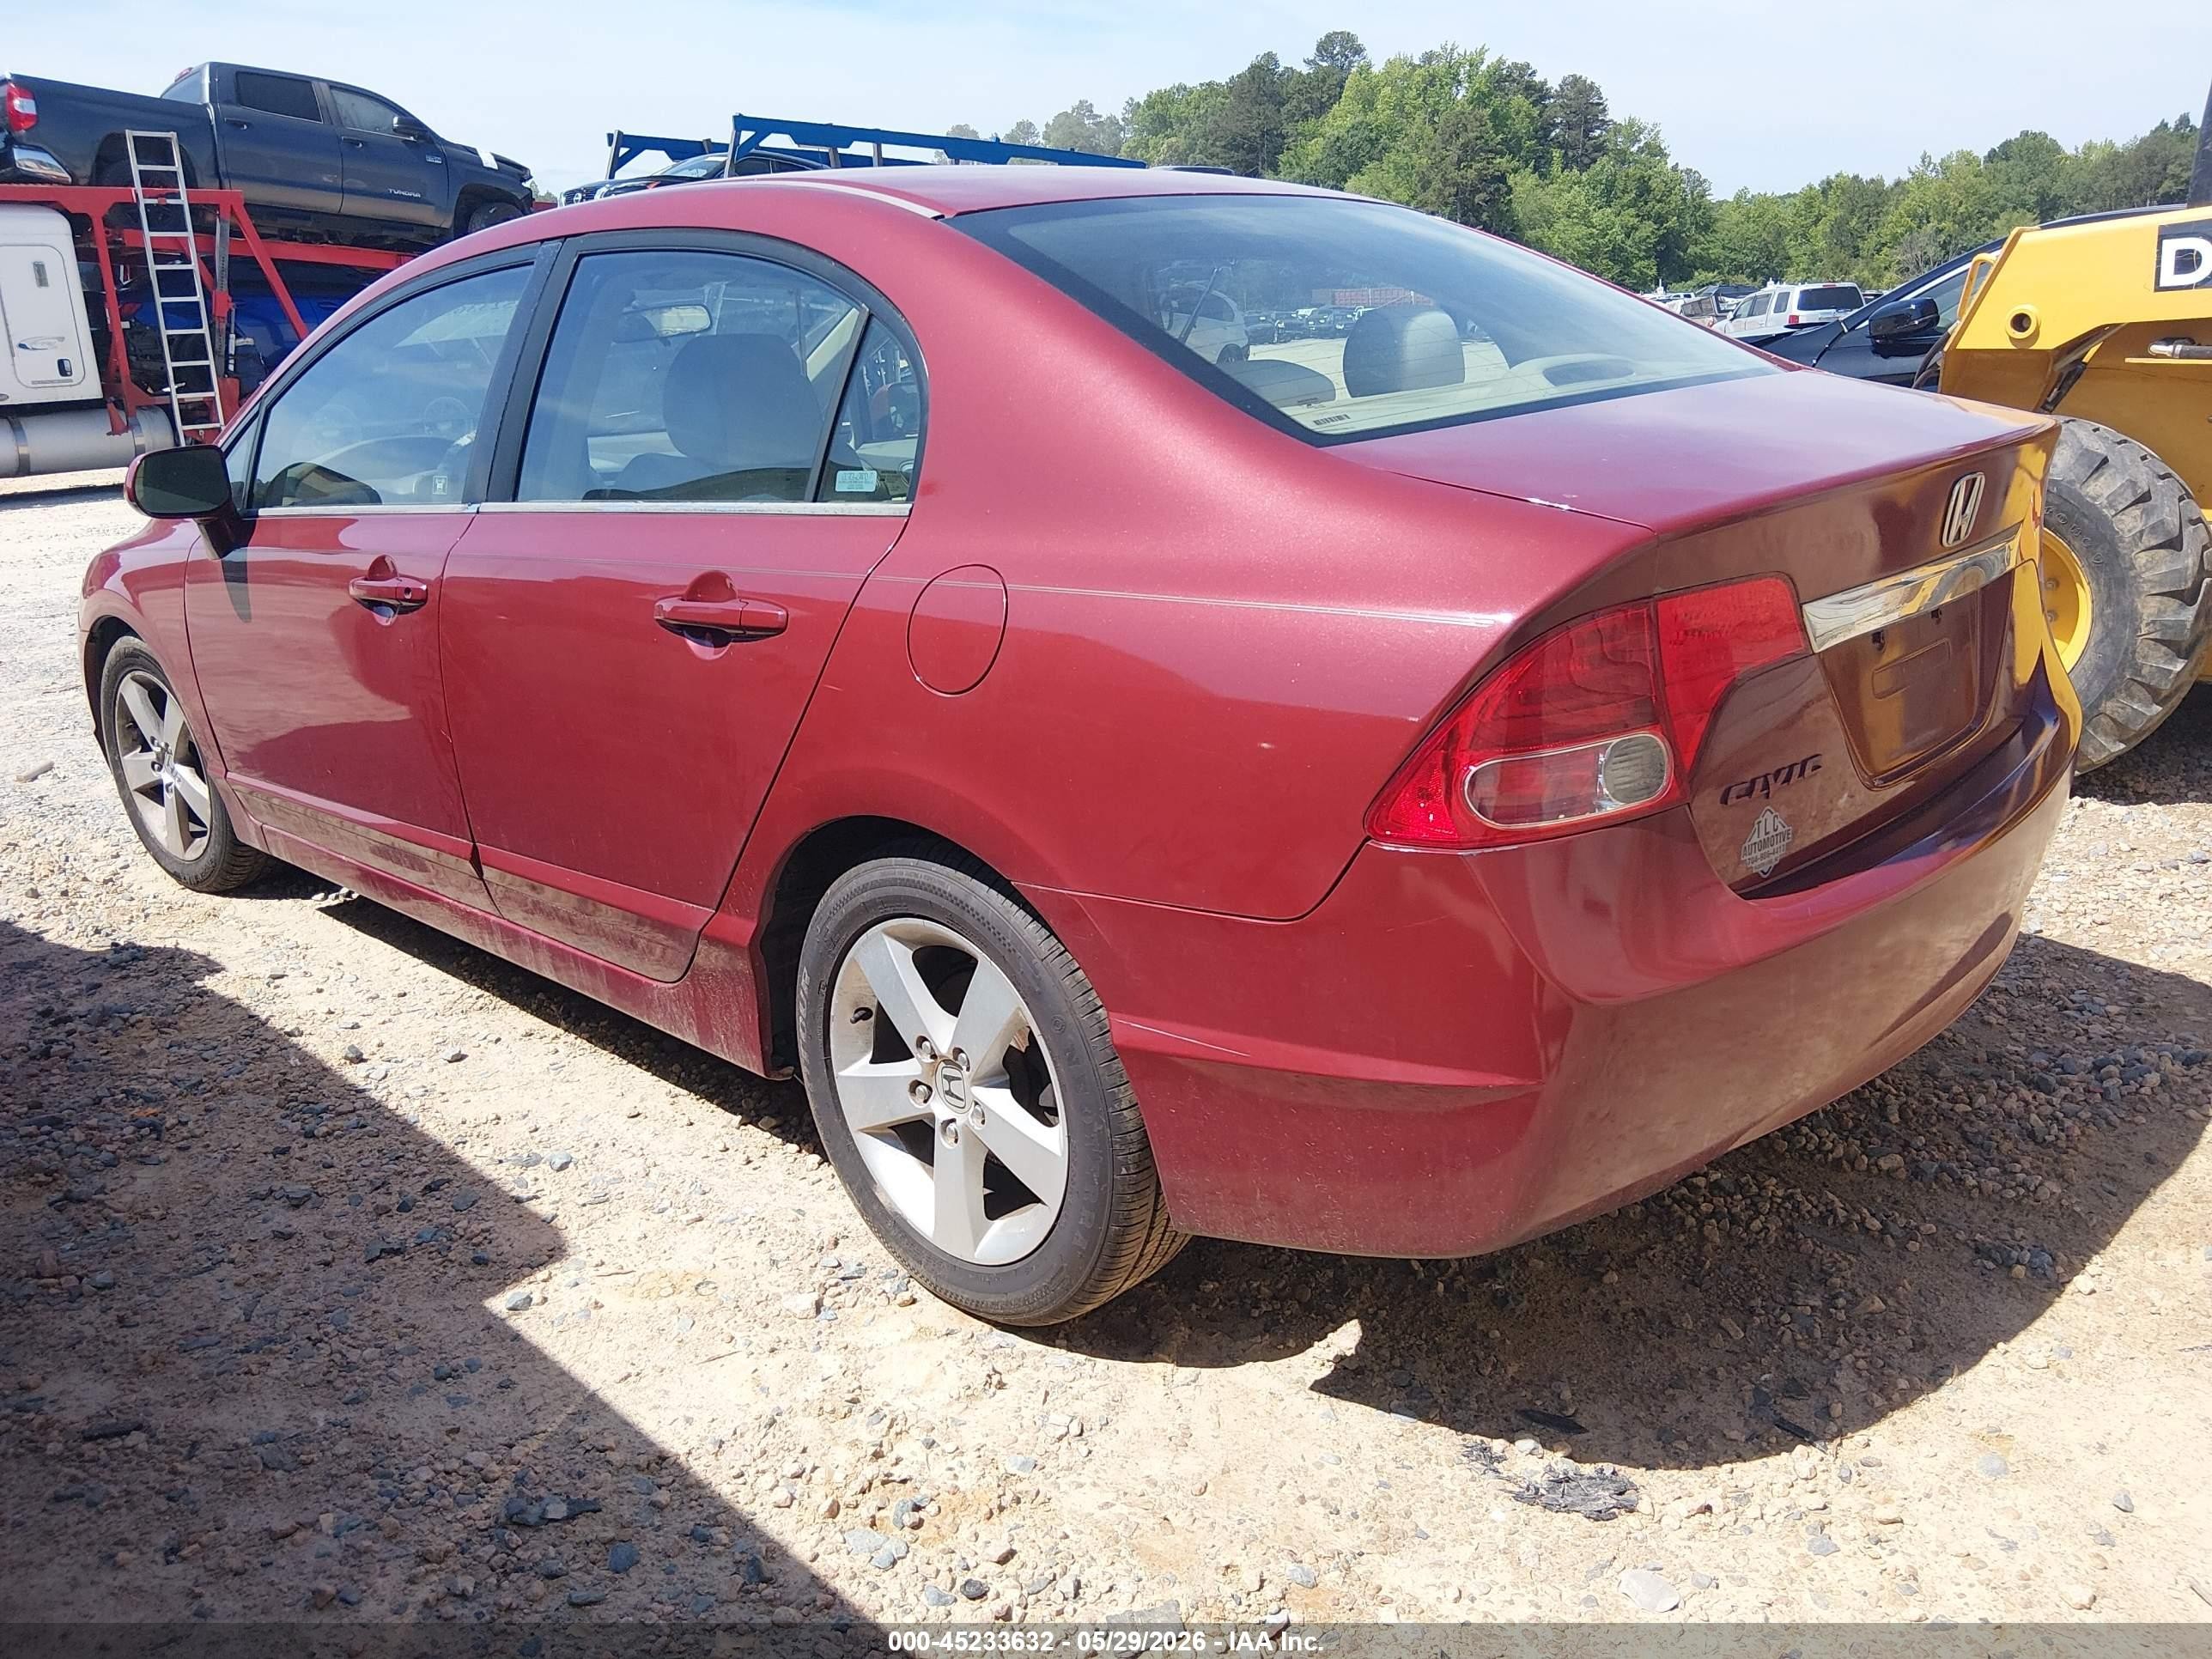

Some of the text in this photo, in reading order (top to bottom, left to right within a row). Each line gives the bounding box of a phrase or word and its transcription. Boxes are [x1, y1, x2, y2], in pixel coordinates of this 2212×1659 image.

[387, 188, 421, 198] TUNDRA
[1719, 753, 1822, 805] CIVIC
[1742, 829, 1791, 859] AUTOMOTIVE
